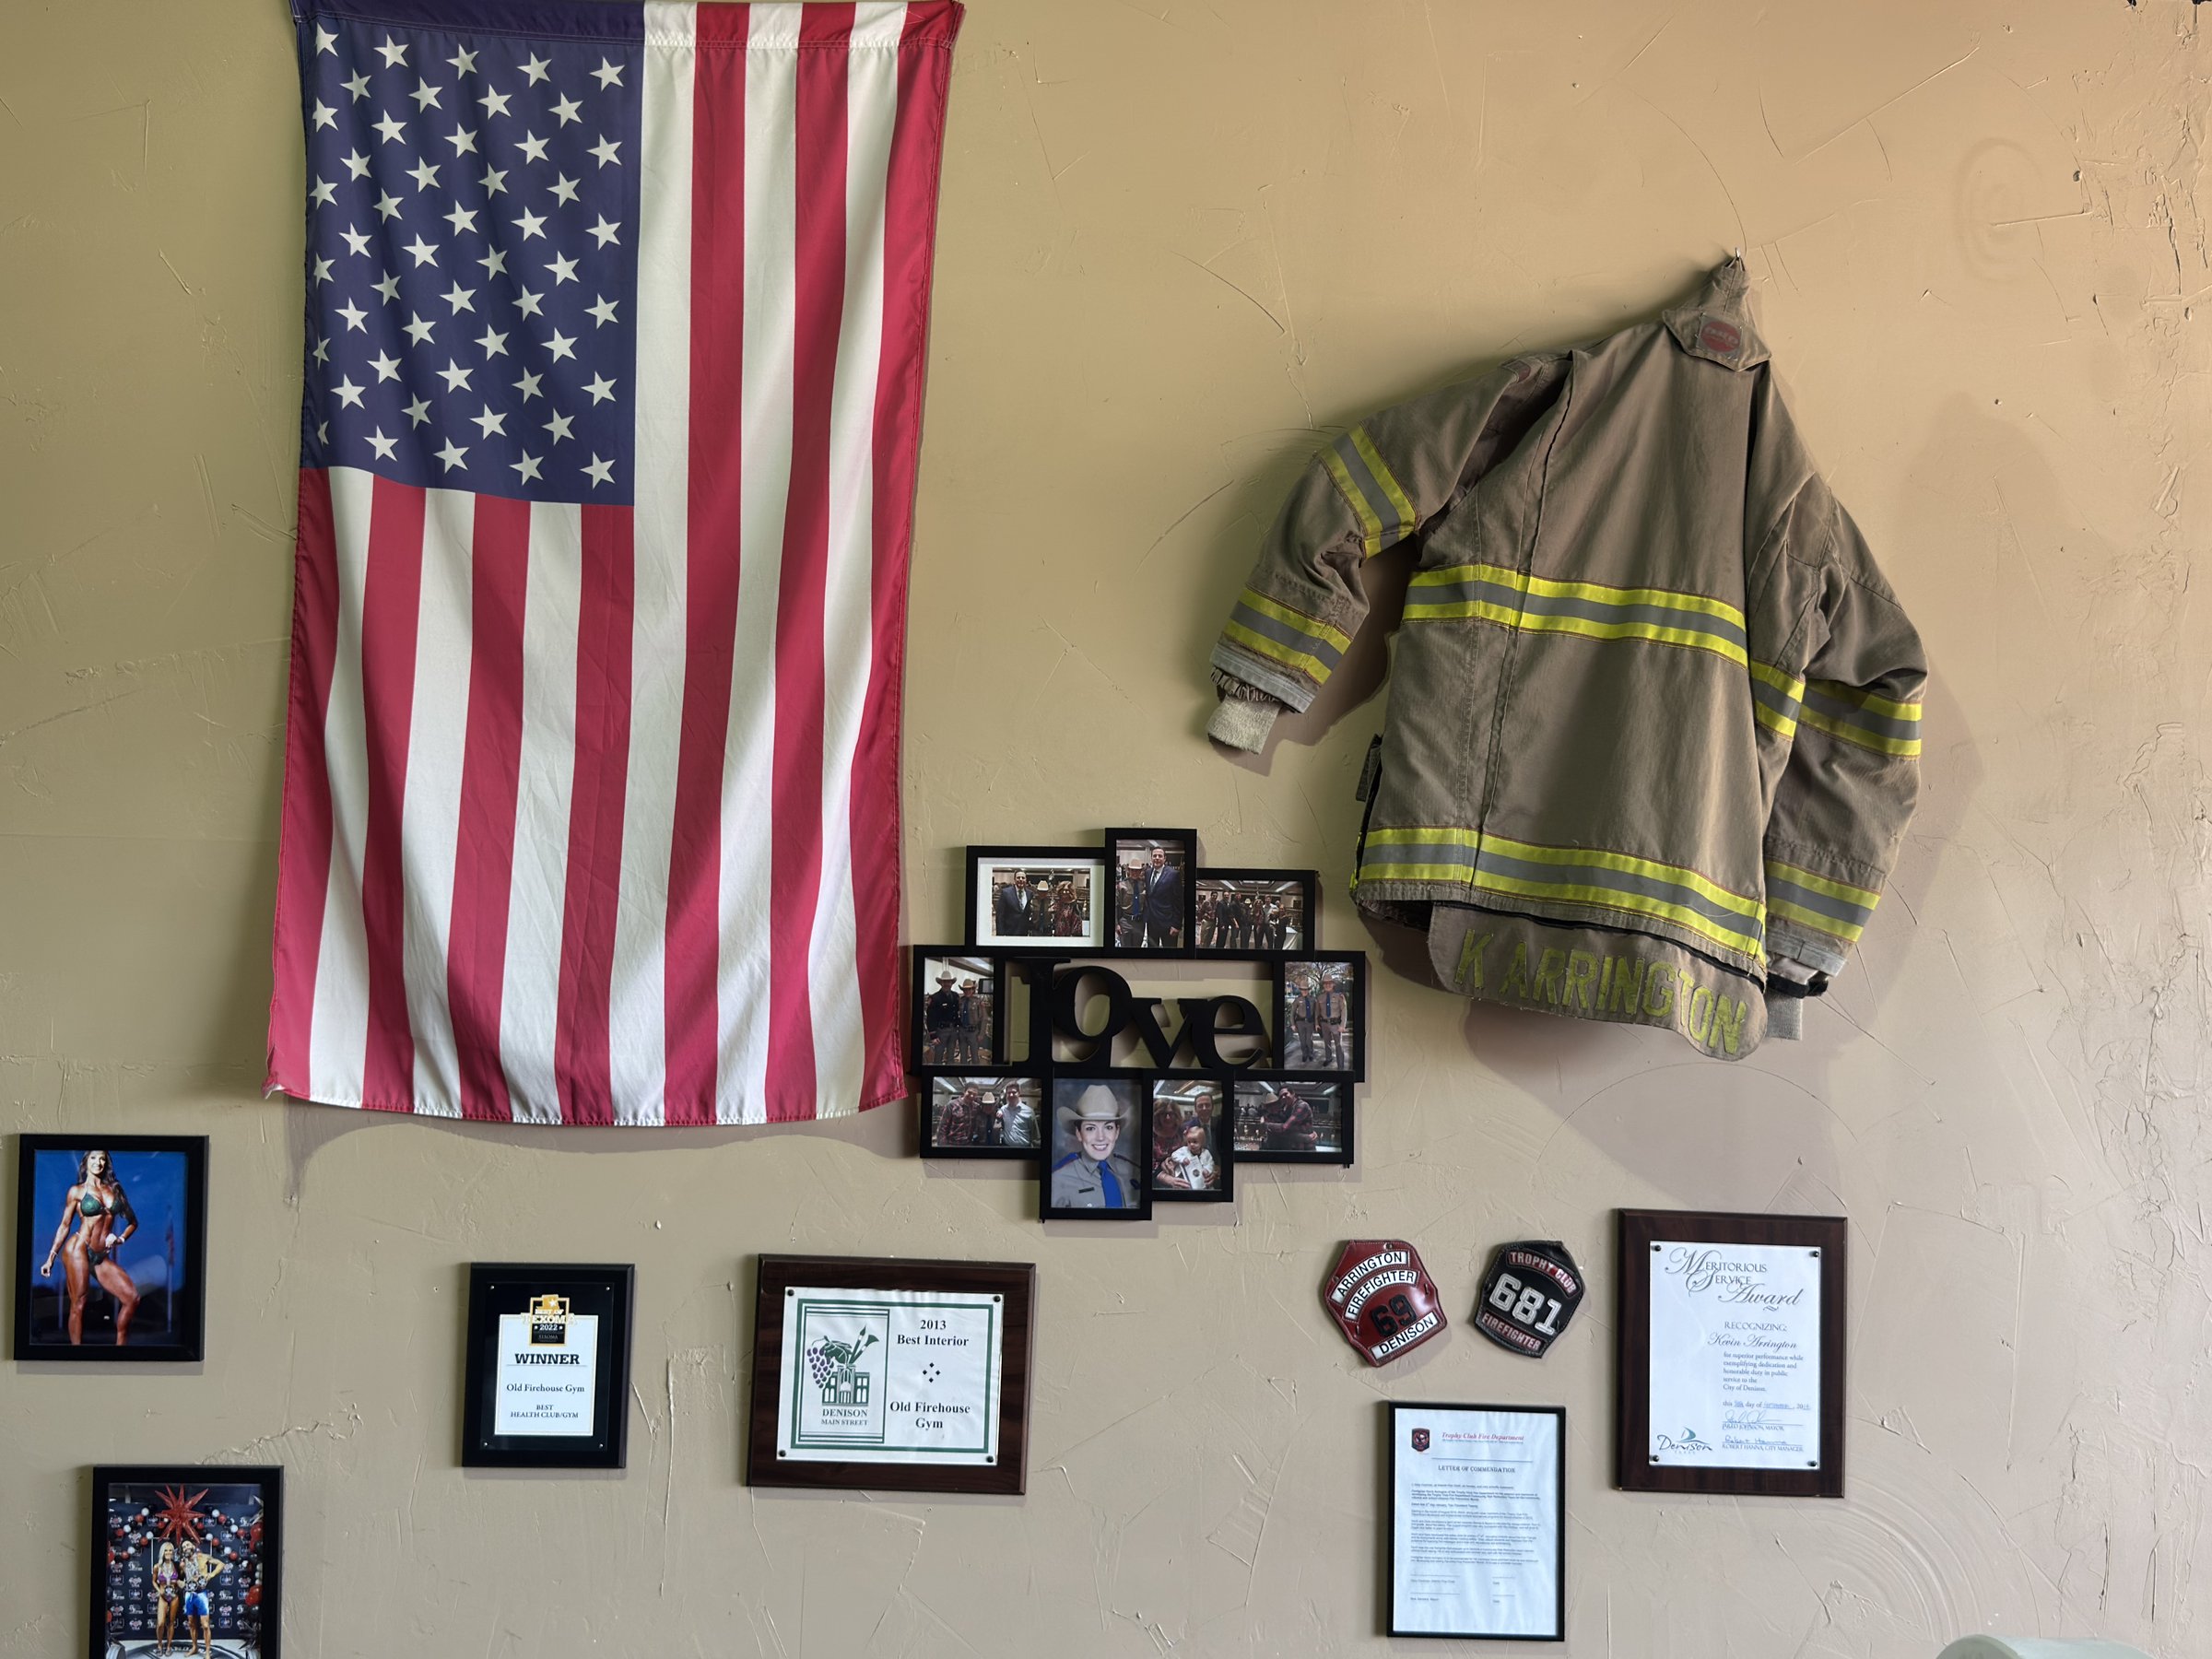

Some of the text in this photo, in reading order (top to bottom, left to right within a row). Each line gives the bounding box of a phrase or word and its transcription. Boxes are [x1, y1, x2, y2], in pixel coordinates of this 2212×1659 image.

[1453, 928, 1747, 1055] K ARRINGTON
[1336, 1253, 1403, 1298] ARRINGTON
[1510, 1252, 1577, 1294] TROPHY CLUB
[1347, 1271, 1415, 1317] FIREFIGHTER
[1488, 1273, 1562, 1335] 681
[521, 1312, 577, 1325] TEXOMA
[1371, 1293, 1418, 1337] 69
[920, 1319, 947, 1330] 2013
[1378, 1316, 1434, 1354] DENISON
[1481, 1312, 1542, 1351] FIREFIGHTER
[897, 1334, 969, 1347] Best Interior
[514, 1353, 581, 1365] WINNER
[1755, 1352, 1788, 1360] performance
[506, 1383, 585, 1394] Old Firehouse Gym
[822, 1408, 868, 1417] DENISON
[889, 1401, 971, 1414] Old Firehouse
[915, 1417, 944, 1430] Gym
[1441, 1431, 1463, 1440] Trophy
[1656, 1434, 1712, 1451] Denison
